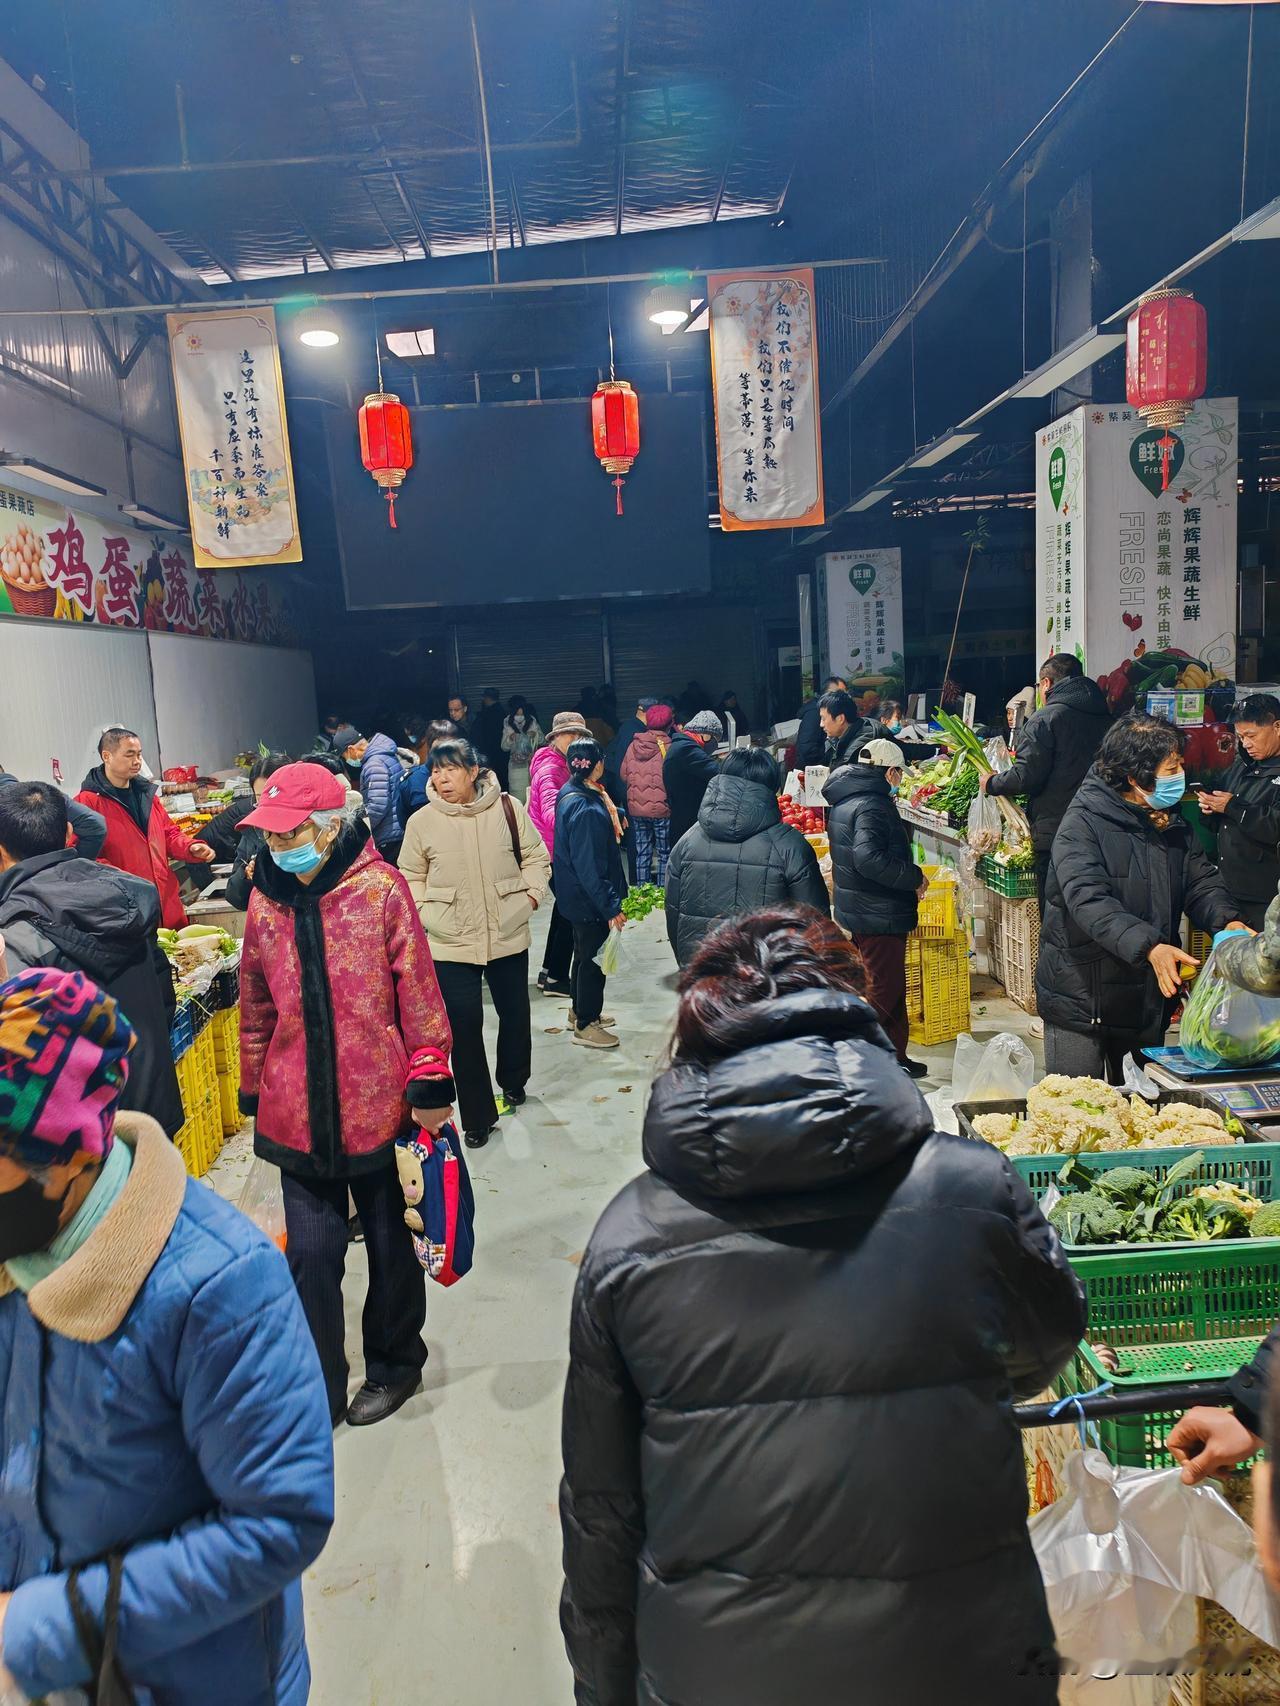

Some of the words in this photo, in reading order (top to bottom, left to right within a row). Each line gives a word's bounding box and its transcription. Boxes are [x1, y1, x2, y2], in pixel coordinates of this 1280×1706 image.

[776, 303, 795, 432] 我们不催促时间
[223, 391, 250, 518] 只有应季而生的
[239, 350, 269, 498] 这里没有标准答案
[209, 448, 231, 540] 千百种新鲜
[1157, 511, 1171, 576] 恋尚果蔬
[46, 512, 139, 624] 鸡蛋
[1119, 511, 1145, 606] FRESH
[1183, 507, 1201, 621] 辉辉果蔬生鲜
[1157, 585, 1171, 649] 快乐由我
